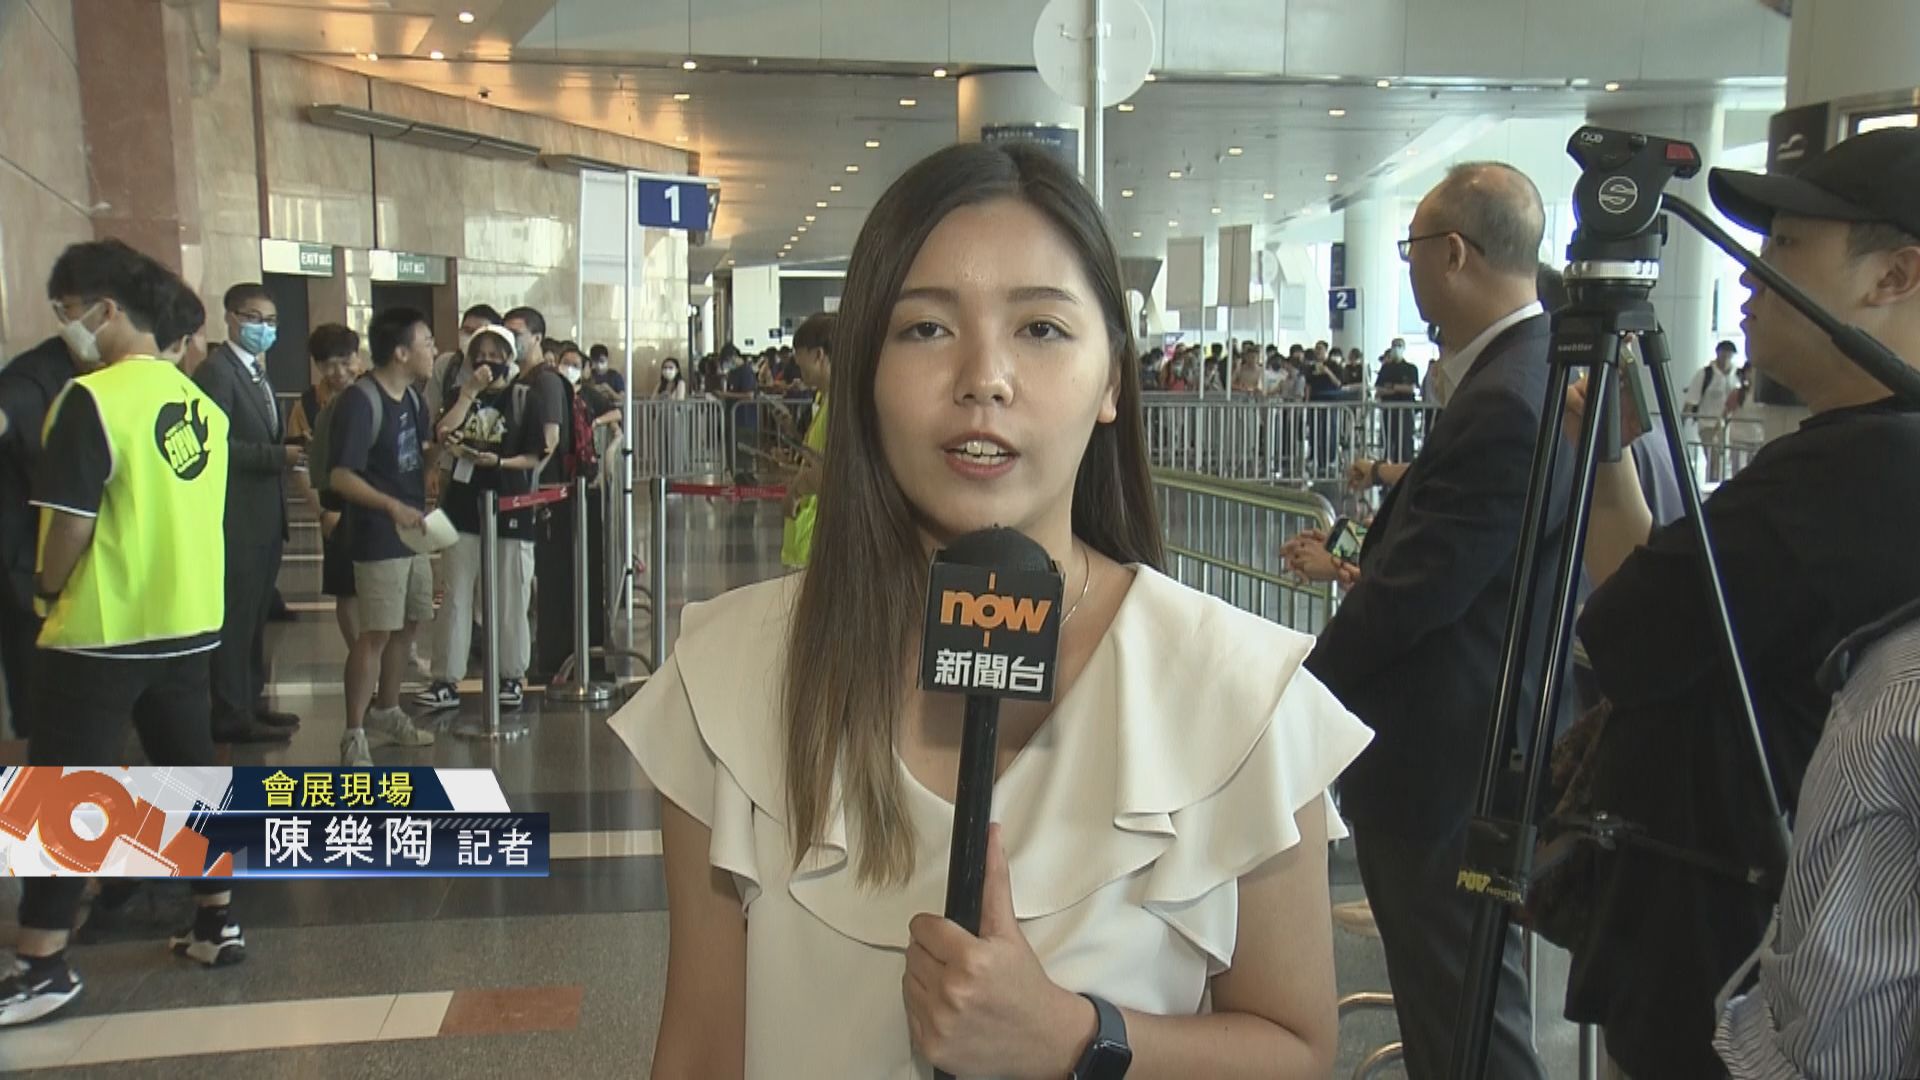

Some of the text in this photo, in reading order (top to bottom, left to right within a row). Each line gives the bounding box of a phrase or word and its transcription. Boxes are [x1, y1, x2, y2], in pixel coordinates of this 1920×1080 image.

[664, 184, 680, 223] 1
[1336, 292, 1348, 309] 2
[940, 589, 1051, 632] now
[933, 648, 1046, 693] 新聞台
